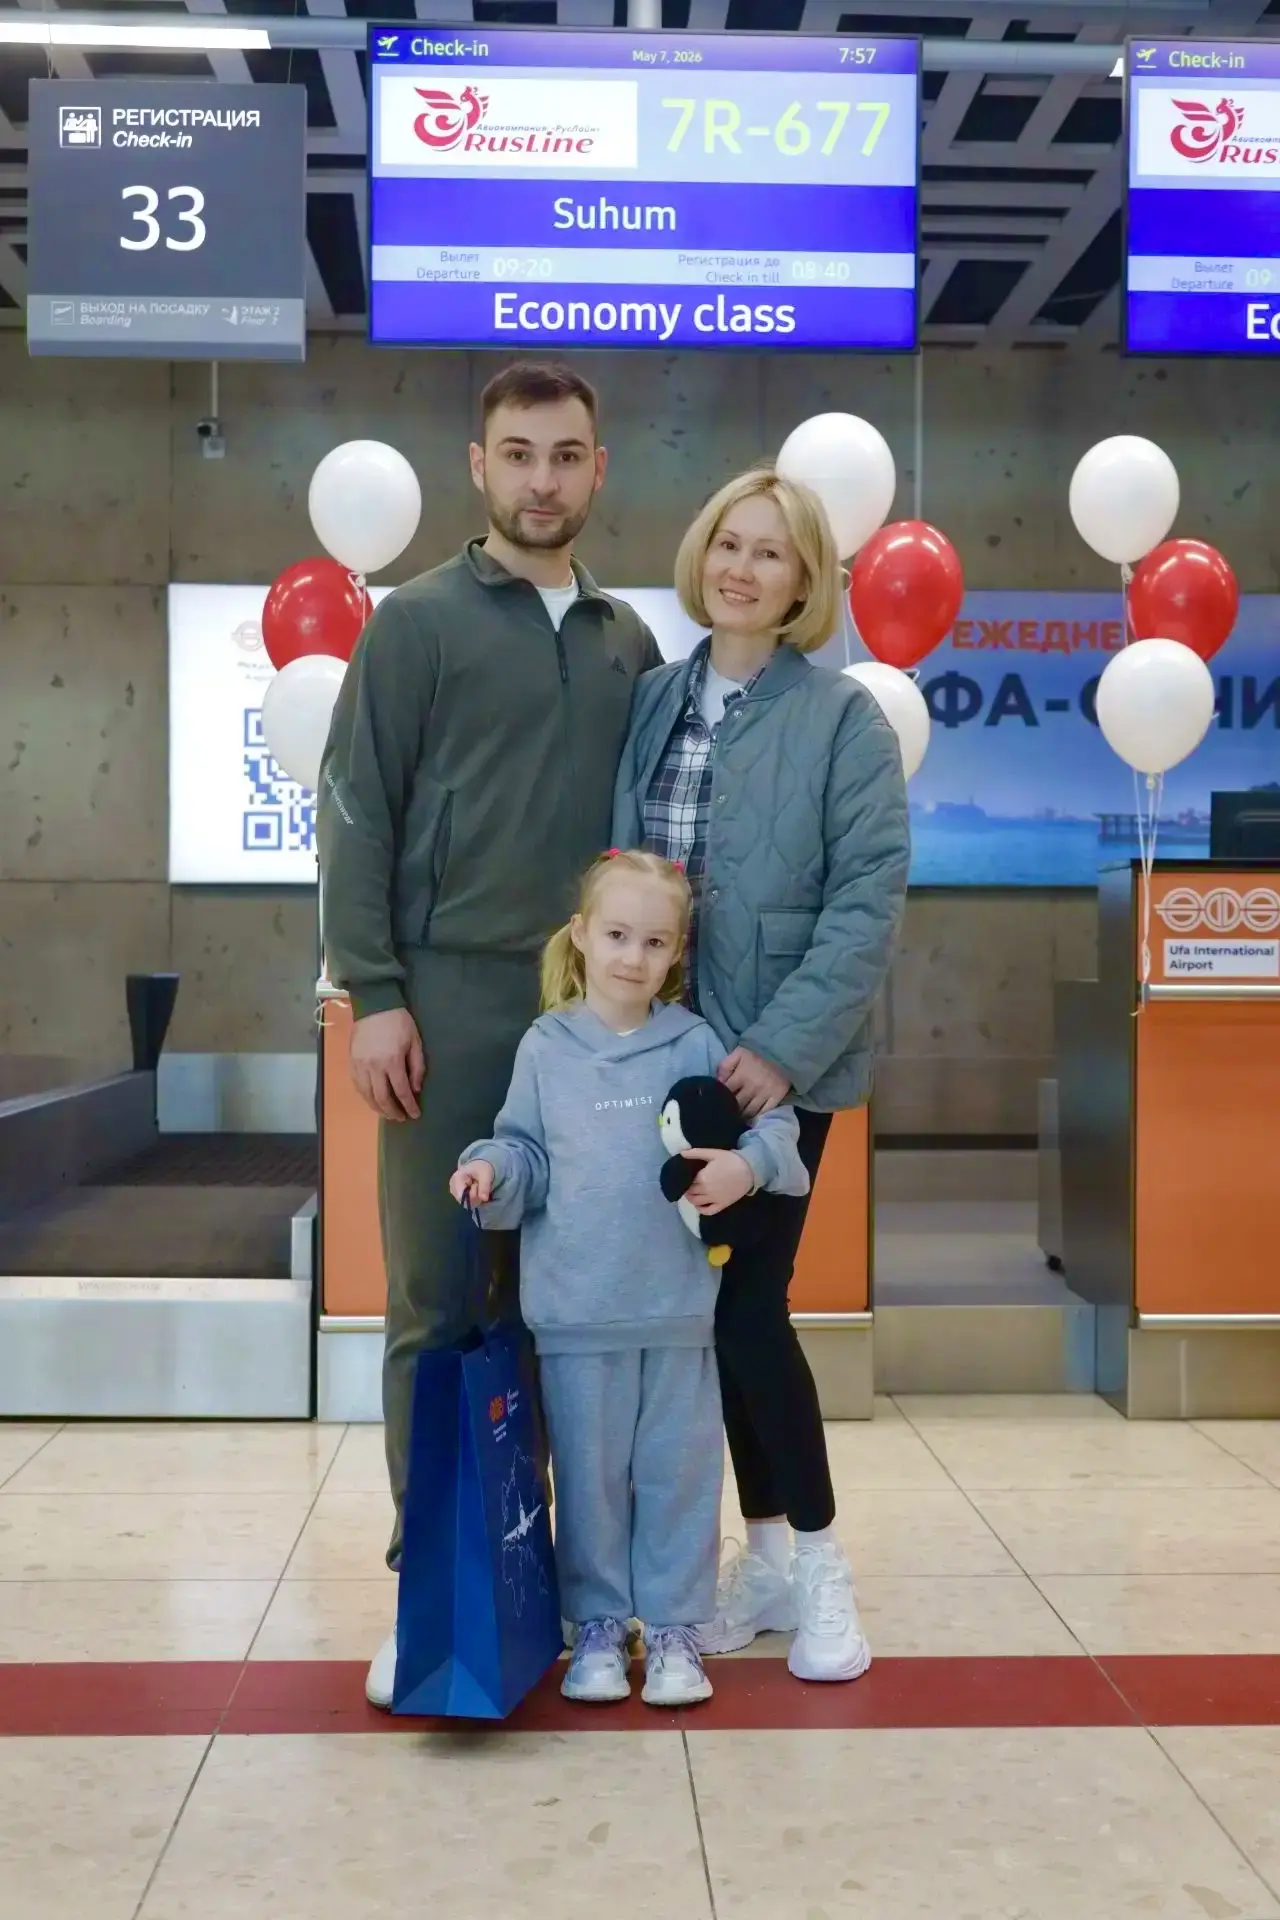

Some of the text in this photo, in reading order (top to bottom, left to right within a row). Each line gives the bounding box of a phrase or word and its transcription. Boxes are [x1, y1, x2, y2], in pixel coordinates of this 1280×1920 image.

[410, 38, 489, 57] Check-in
[838, 47, 877, 64] 7:57
[632, 50, 703, 64] May 7, 2026
[1168, 50, 1246, 69] Check-in
[112, 108, 261, 130] РЕГИСТРАЦИЯ
[661, 98, 891, 157] 7R-677
[112, 130, 193, 148] Check-in
[1219, 145, 1280, 164] Rus
[119, 185, 207, 252] 33
[552, 197, 677, 231] Suhum
[440, 251, 480, 263] Вылет
[678, 254, 780, 268] Регистрация до
[416, 267, 480, 281] Departure
[493, 257, 552, 277] 09:20
[705, 271, 780, 283] Check in till
[1171, 277, 1234, 291] Departure
[80, 302, 210, 316] ВЫХОД НА ПОСАДКУ
[493, 293, 796, 340] Economy class
[80, 315, 132, 327] Boarding
[951, 620, 1134, 655] ЕЖЕДНЕ
[1169, 945, 1274, 955] Ufa International
[1169, 959, 1213, 971] Airport
[595, 1096, 653, 1110] OPTIMIST
